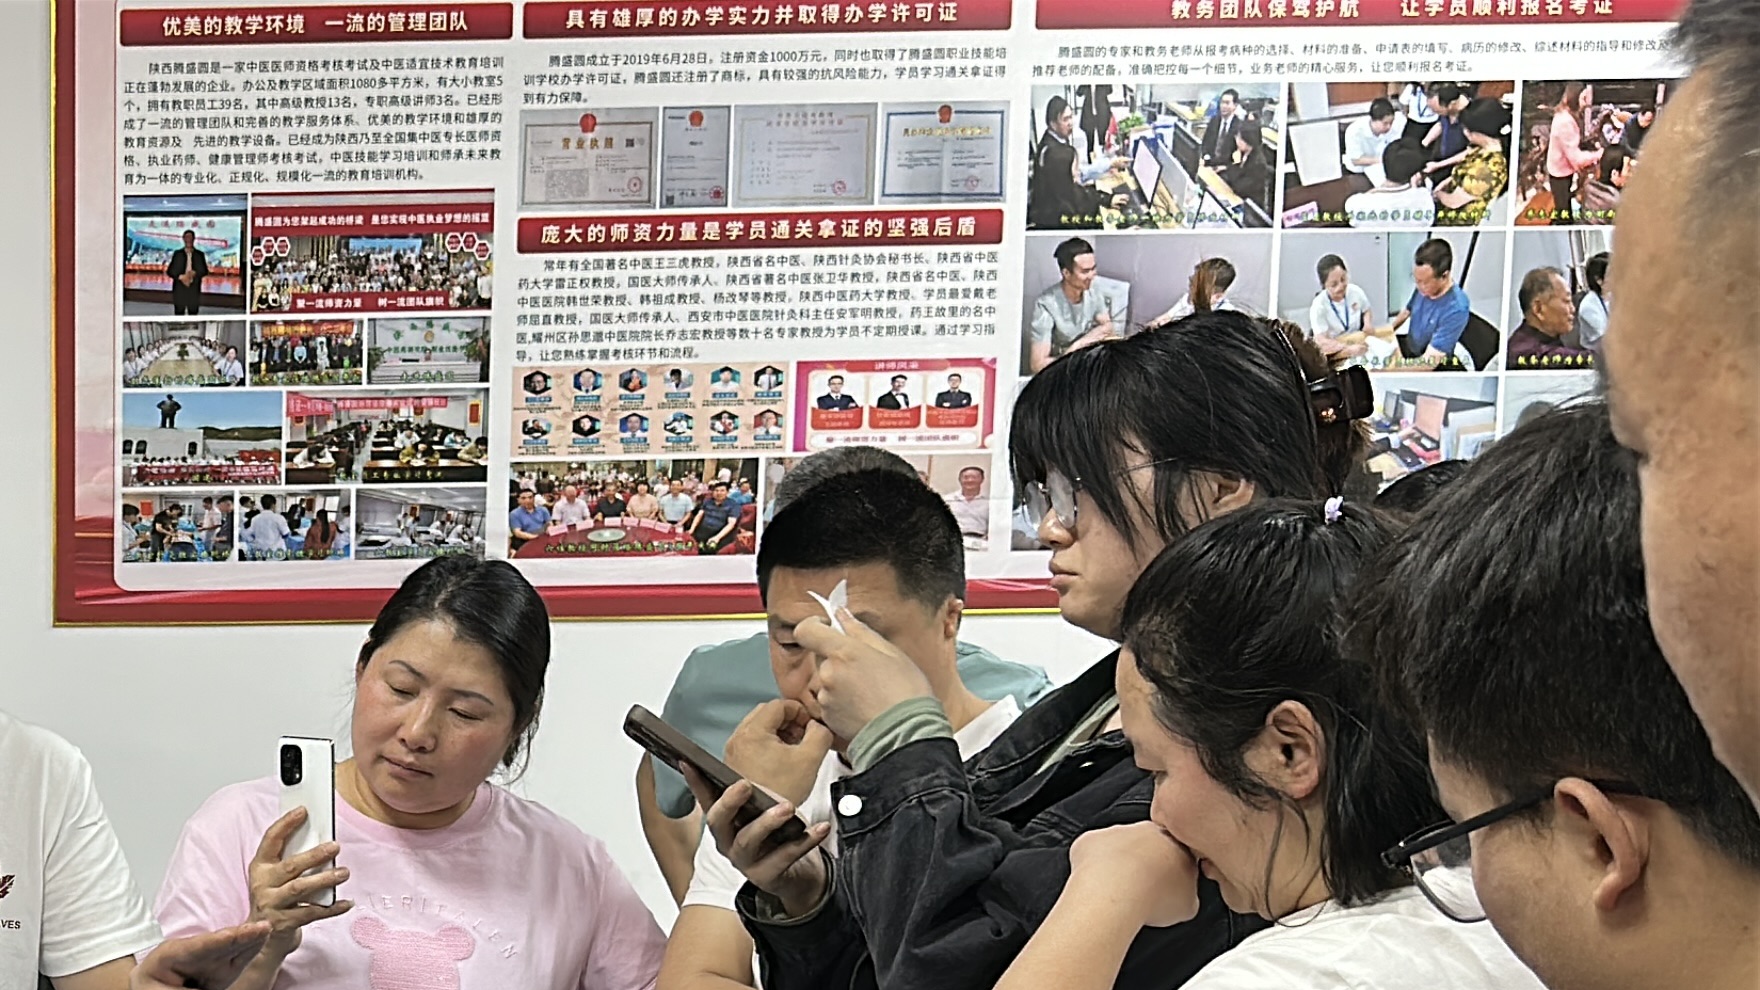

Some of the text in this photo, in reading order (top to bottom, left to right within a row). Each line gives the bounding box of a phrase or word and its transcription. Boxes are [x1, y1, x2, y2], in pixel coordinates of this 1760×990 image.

[565, 2, 959, 30] 具有雄厚的办学实力并取得办学许可证
[1171, 0, 1614, 20] 教务团队保驾护航 让学员顺利报名考证
[162, 11, 468, 37] 优美的教学环境 一流的管理团队
[523, 91, 589, 104] 到有力保障。
[124, 136, 183, 149] 教育资源及
[541, 217, 977, 245] 庞大的师资力量是学员通关拿证的坚强后盾
